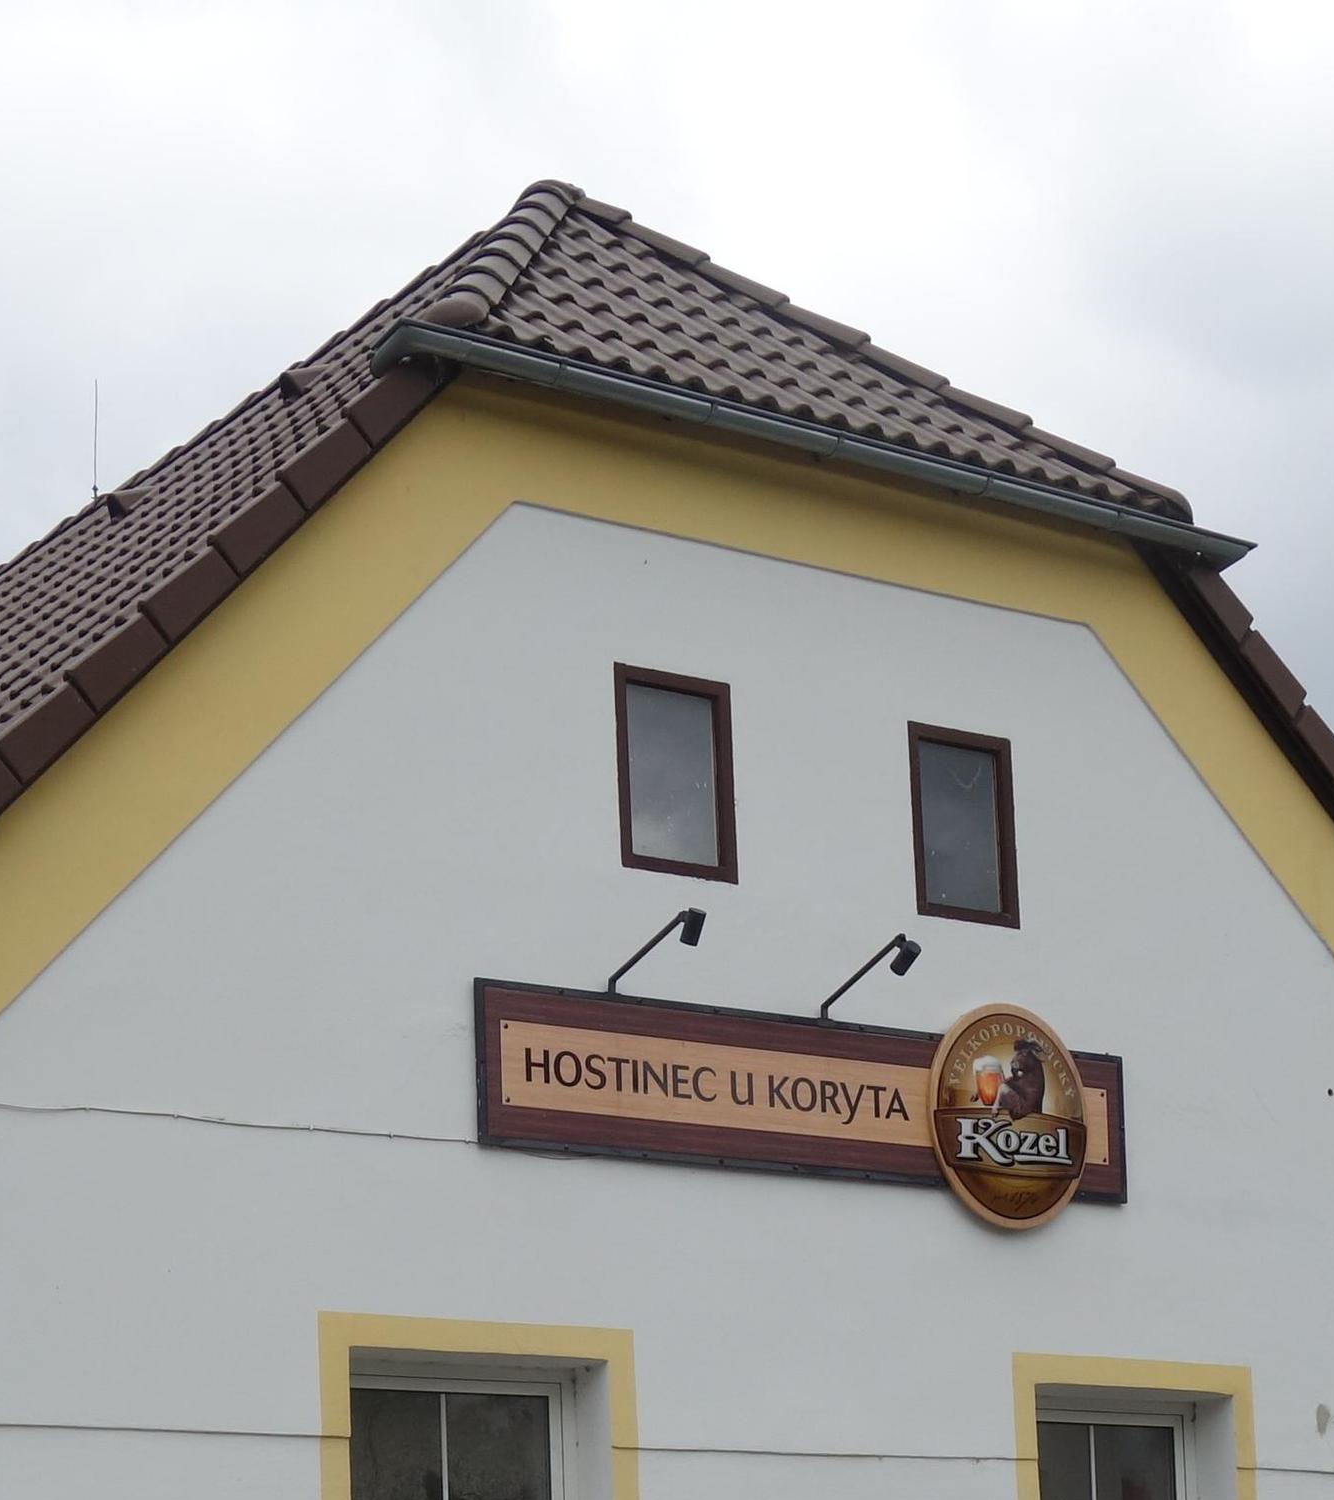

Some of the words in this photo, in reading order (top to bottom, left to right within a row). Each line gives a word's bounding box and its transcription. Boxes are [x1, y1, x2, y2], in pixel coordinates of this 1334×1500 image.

[524, 1047, 718, 1102] HOSTINEC
[768, 1074, 911, 1125] KORYTA
[955, 1117, 1072, 1166] Kozel
